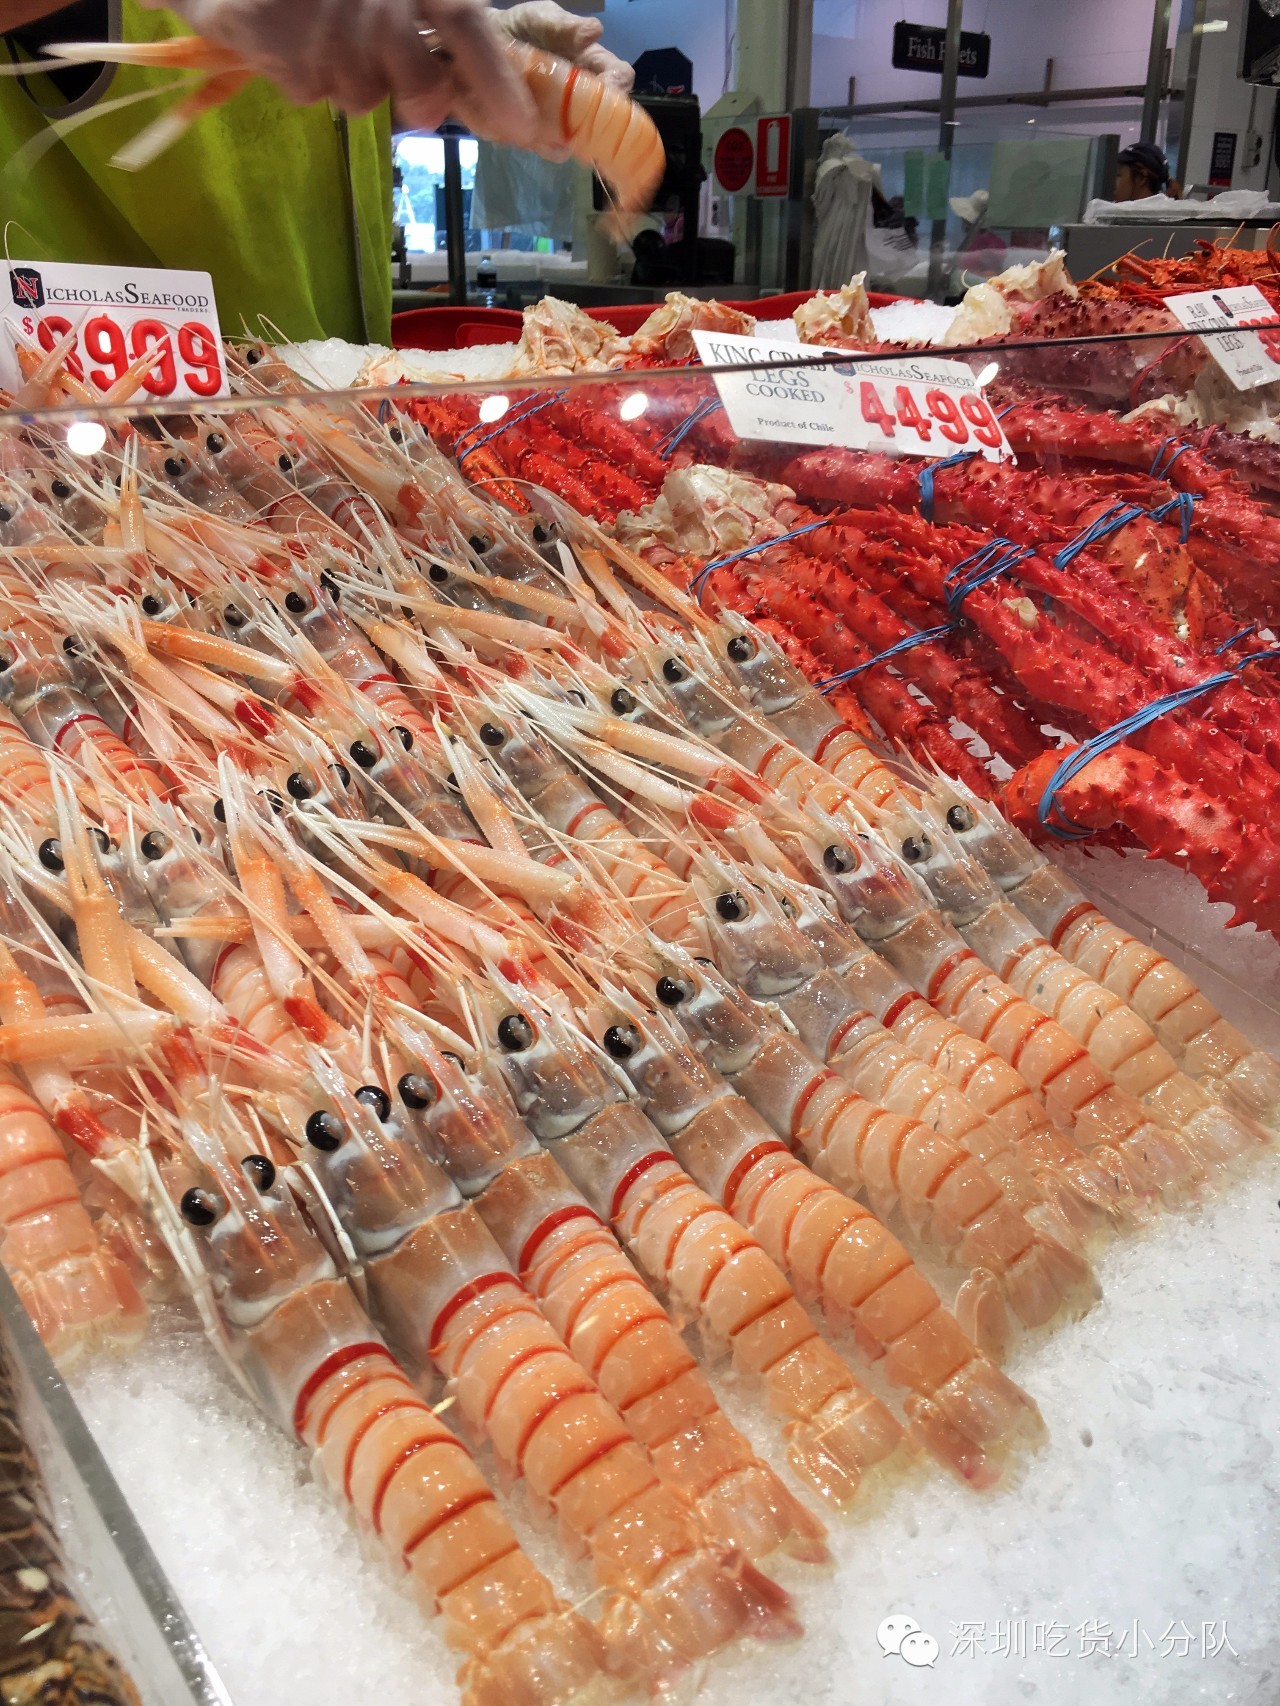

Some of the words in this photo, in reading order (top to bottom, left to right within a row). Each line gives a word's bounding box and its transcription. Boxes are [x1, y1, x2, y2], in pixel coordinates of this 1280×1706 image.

[907, 37, 936, 59] Fish
[938, 41, 978, 65] Fets
[1216, 333, 1245, 352] LEGS
[707, 342, 765, 365] KING
[751, 368, 810, 388] LEGS
[745, 383, 826, 403] COOKED
[757, 417, 796, 429] Product
[797, 421, 807, 430] of
[809, 422, 835, 432] Chile
